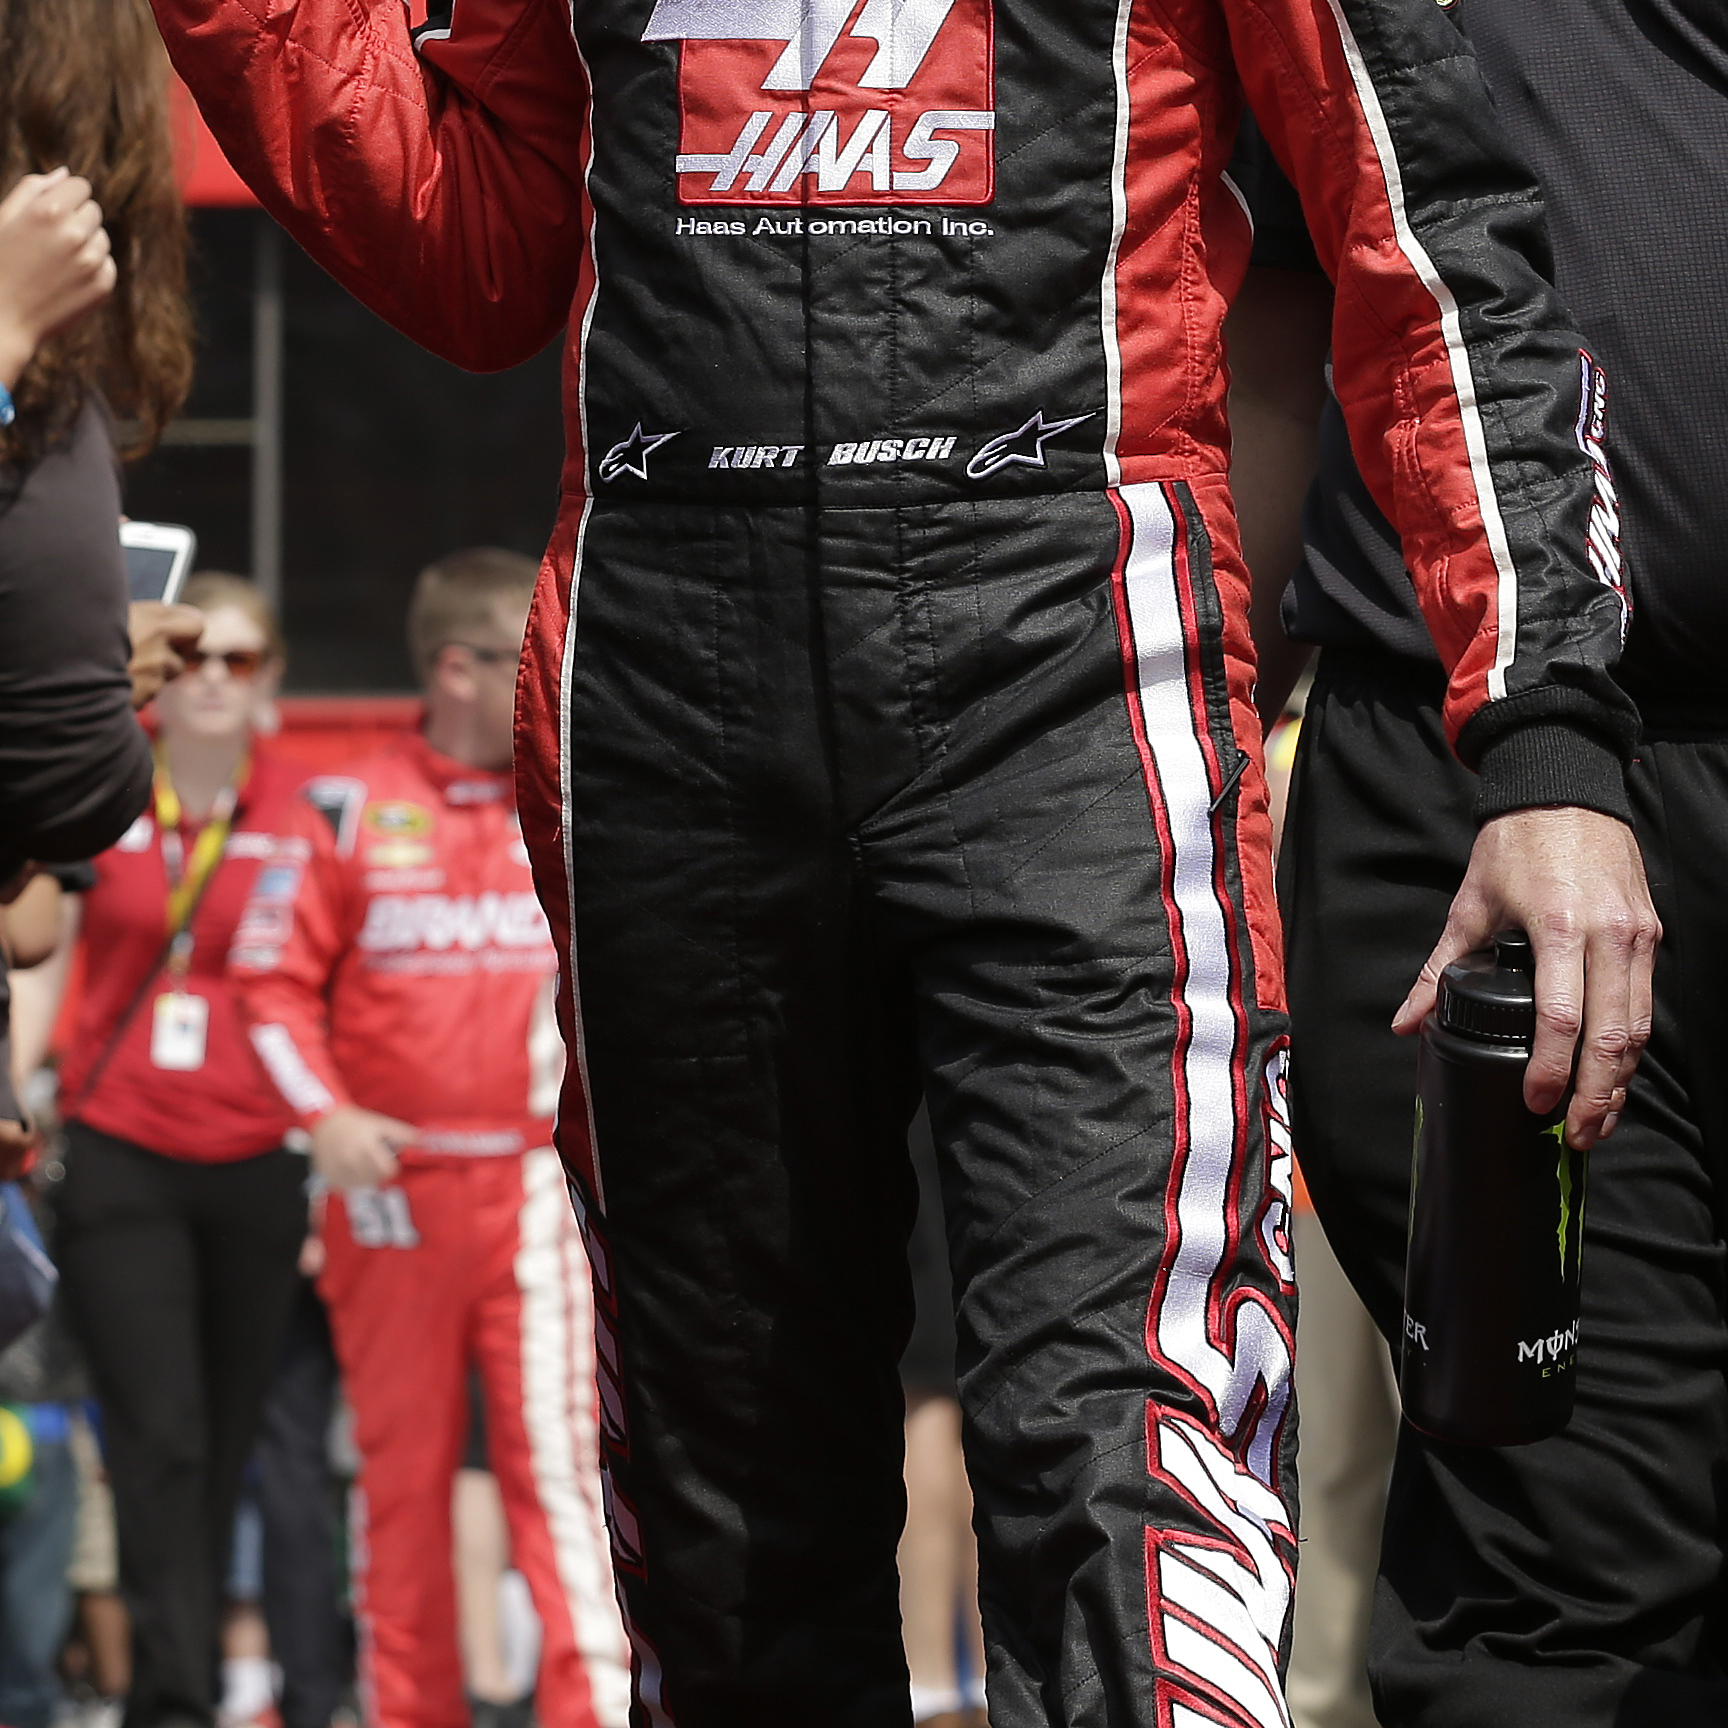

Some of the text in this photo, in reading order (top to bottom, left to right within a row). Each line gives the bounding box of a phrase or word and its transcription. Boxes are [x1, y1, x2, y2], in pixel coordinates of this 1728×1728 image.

[675, 109, 996, 192] HAAS
[675, 216, 995, 236] Haas Automation Inc.
[708, 436, 957, 469] KURT BUSCH
